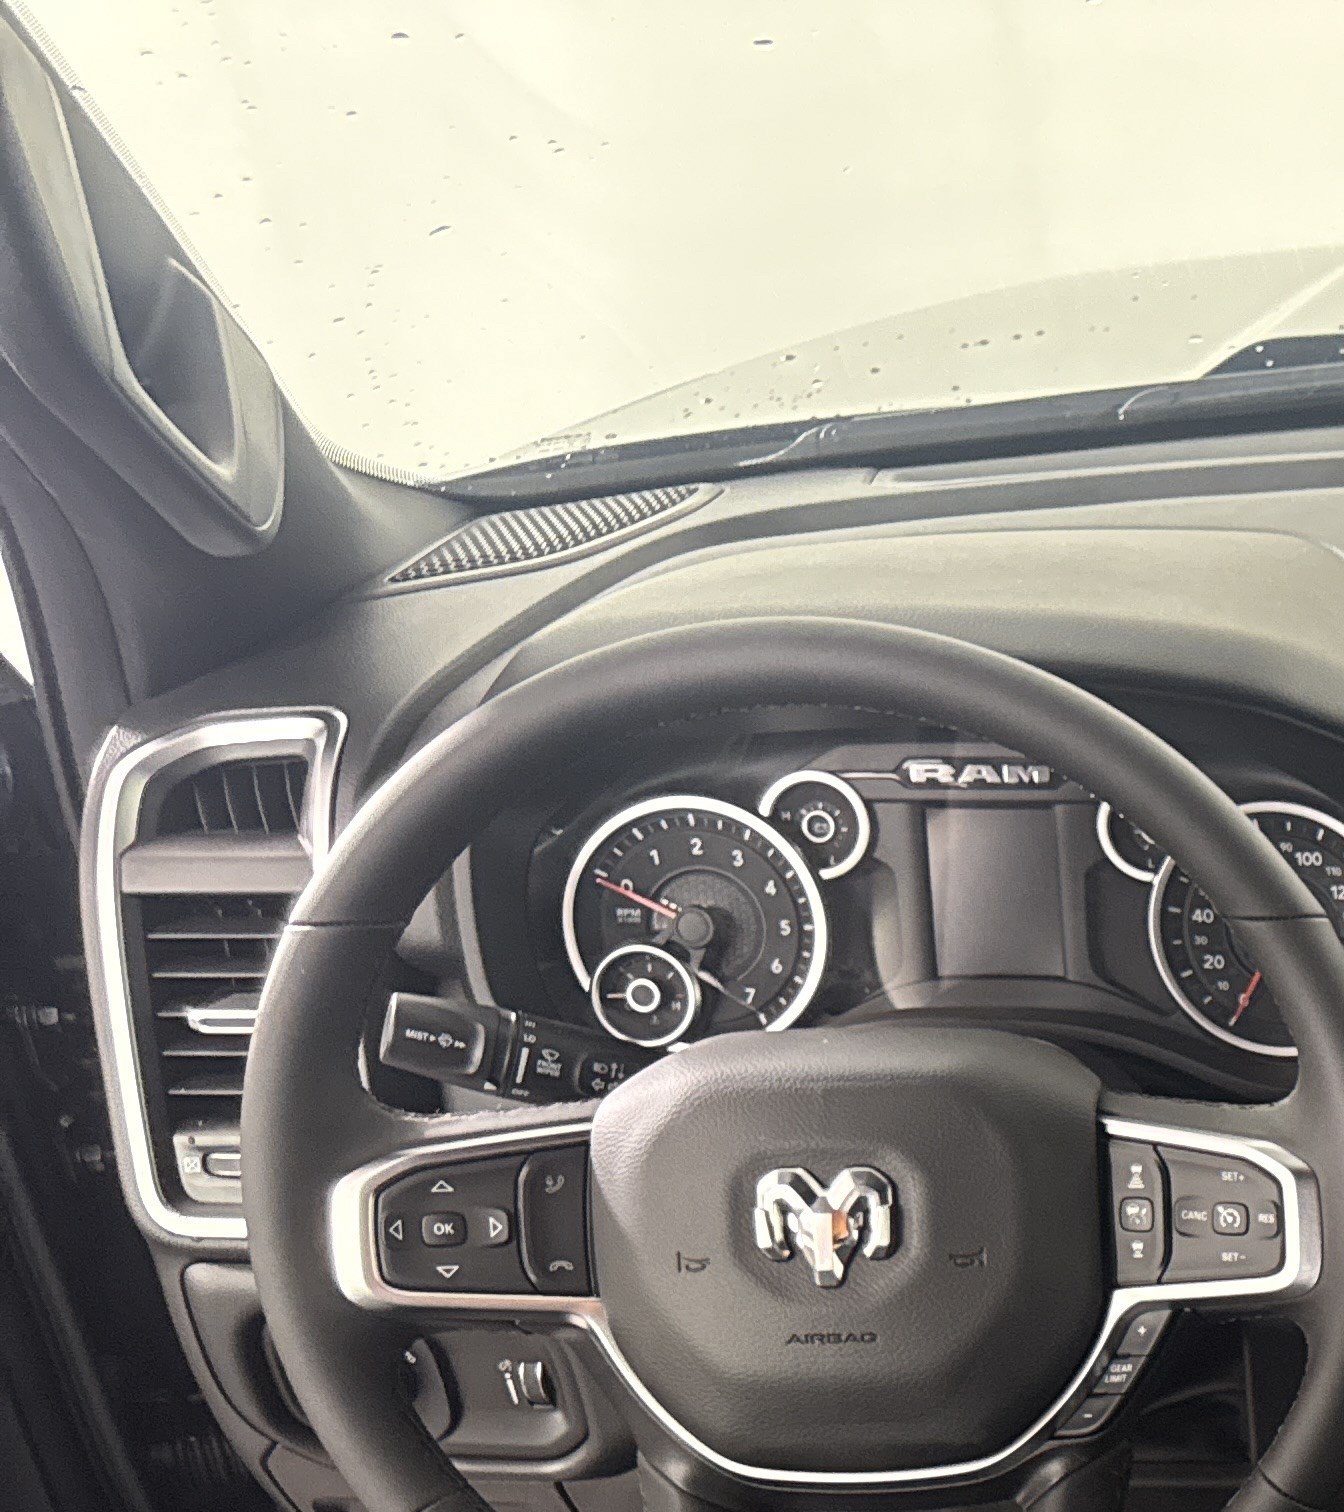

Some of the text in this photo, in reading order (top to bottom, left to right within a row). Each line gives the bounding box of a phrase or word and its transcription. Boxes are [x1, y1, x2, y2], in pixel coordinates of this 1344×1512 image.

[902, 758, 1051, 787] RAM
[689, 837, 704, 856] 2
[649, 849, 661, 866] 1
[731, 849, 745, 868] 3
[1294, 851, 1324, 867] 100
[765, 879, 777, 897] 4
[1191, 908, 1215, 925] 40
[779, 919, 792, 937] 5
[771, 957, 783, 975] 6
[1203, 954, 1226, 971] 20
[744, 986, 756, 1005] 7
[405, 1028, 430, 1043] MIST
[1181, 1210, 1208, 1222] CANC
[432, 1222, 455, 1236] OK
[785, 1331, 879, 1346] AIRBAG
[1110, 1363, 1133, 1373] GEAR
[1104, 1373, 1128, 1384] LIMIT
